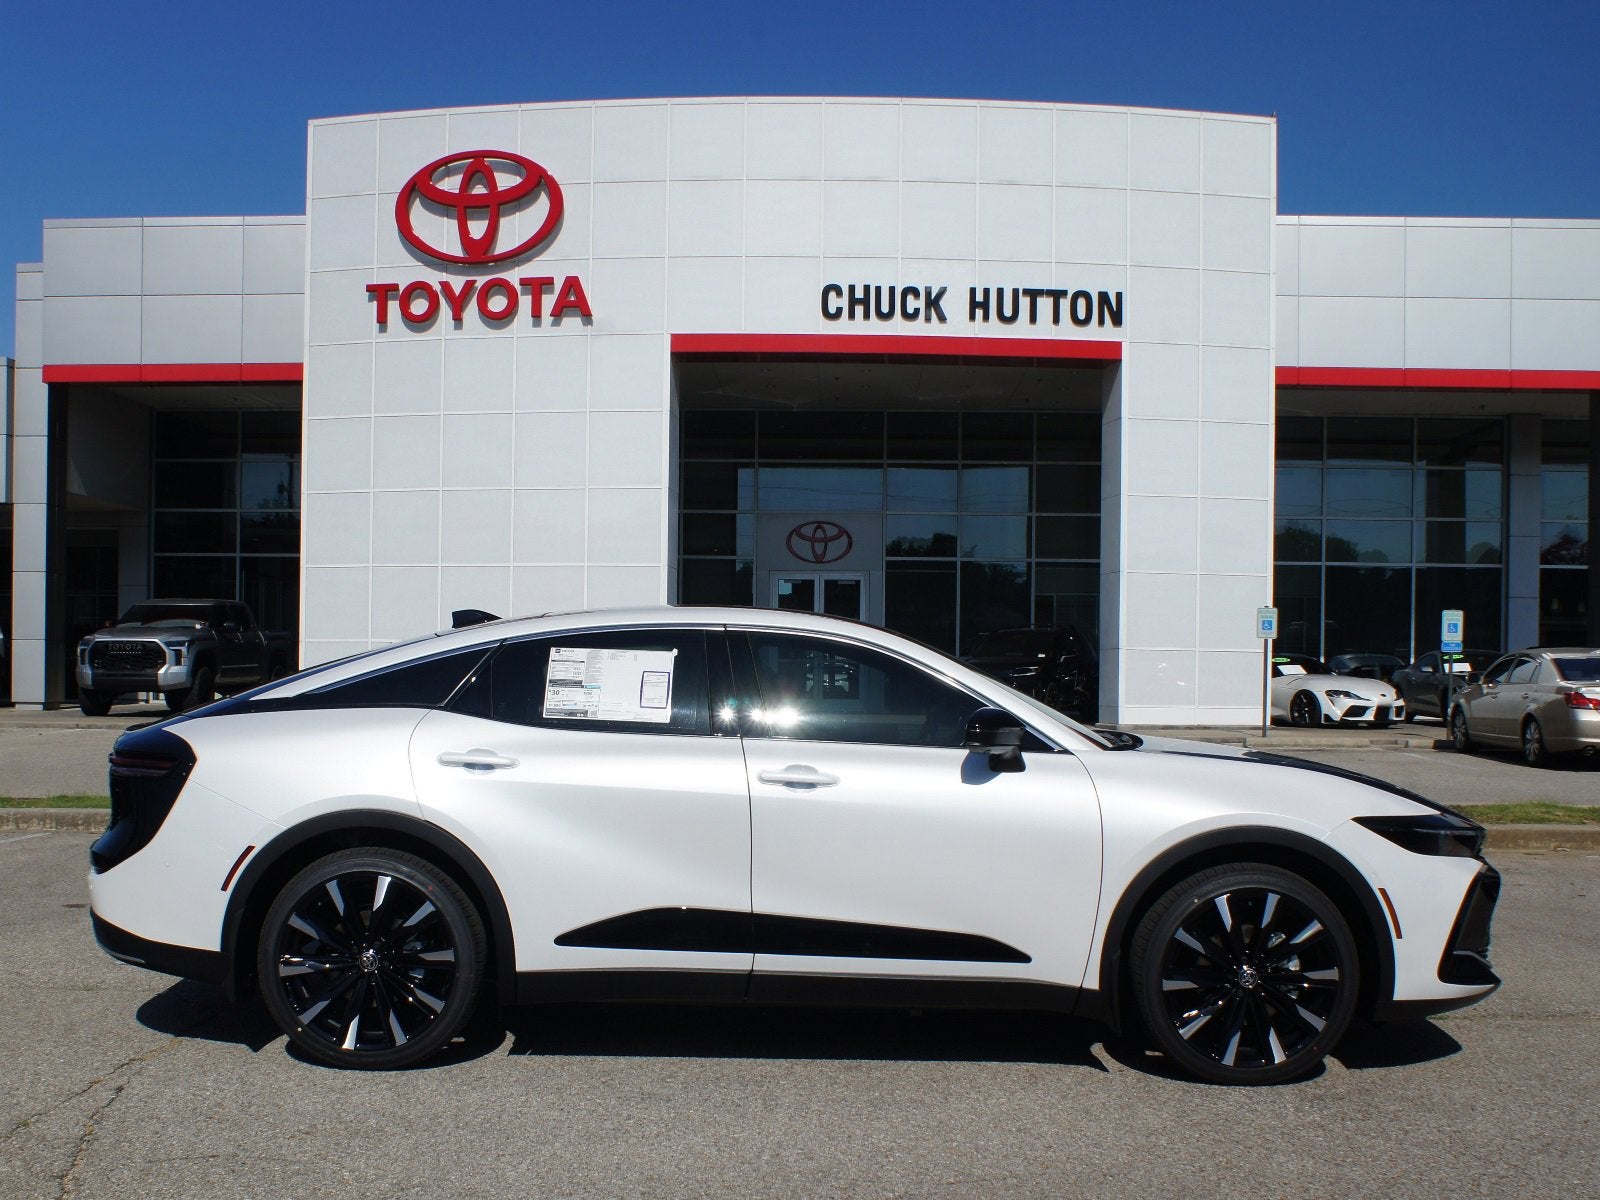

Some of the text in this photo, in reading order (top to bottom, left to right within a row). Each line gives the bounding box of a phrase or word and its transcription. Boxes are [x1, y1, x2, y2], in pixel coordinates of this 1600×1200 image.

[365, 275, 593, 325] TOYOTA
[820, 283, 1123, 328] CHUCK HUTTON
